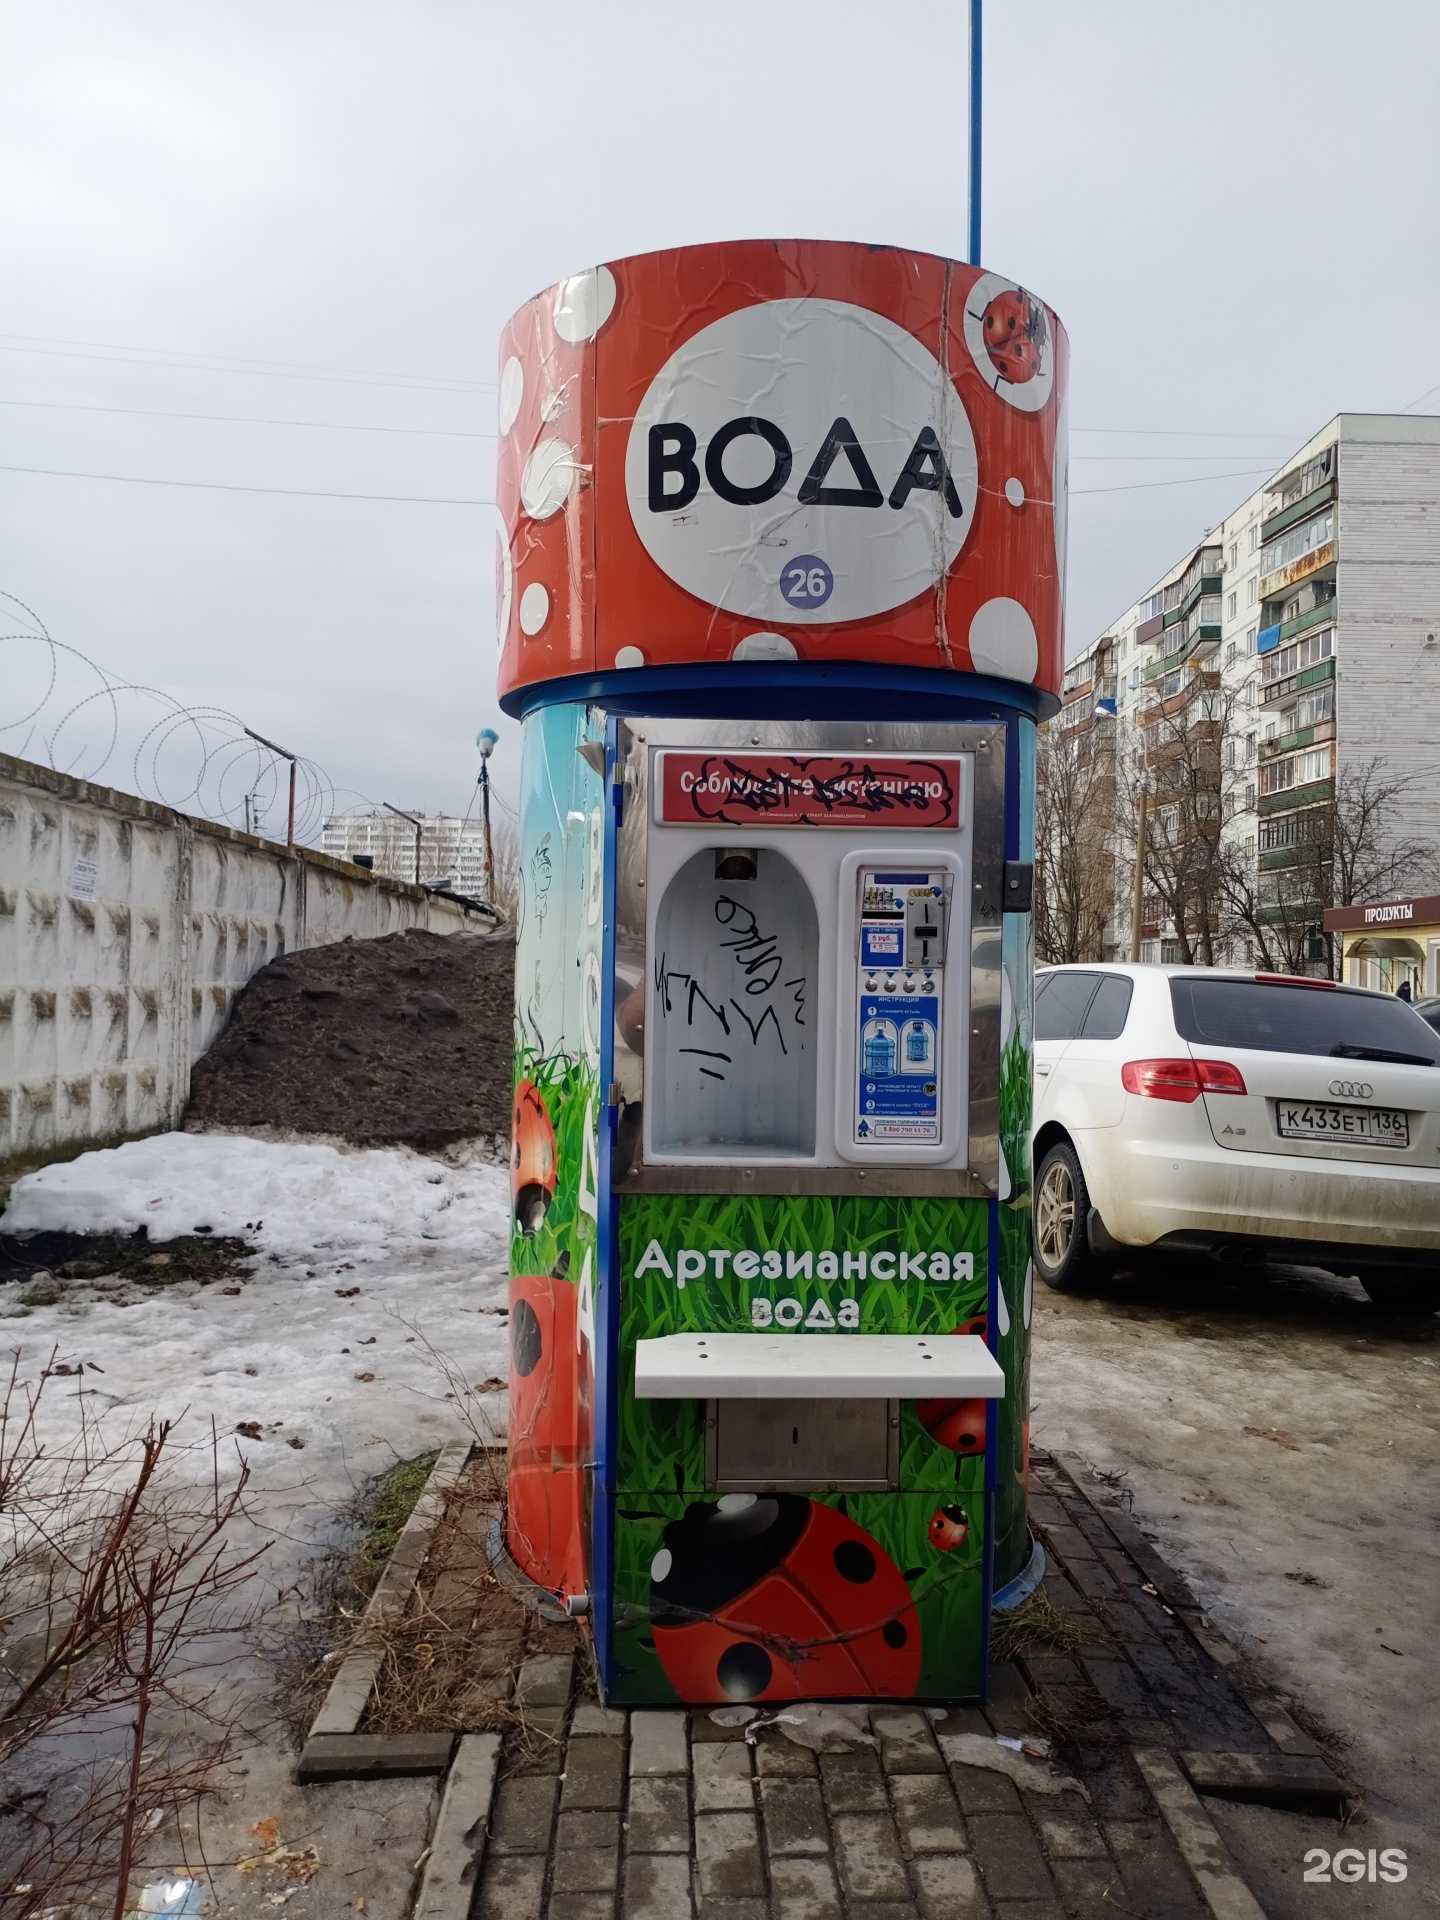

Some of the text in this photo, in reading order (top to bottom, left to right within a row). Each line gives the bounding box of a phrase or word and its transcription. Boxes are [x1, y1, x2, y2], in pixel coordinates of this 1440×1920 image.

[648, 416, 963, 518] ВОДА
[788, 569, 826, 598] 26
[1364, 904, 1413, 923] ПРОДУКТЫ
[1372, 1113, 1402, 1130] 136
[634, 1239, 974, 1289] Артезианская
[751, 1298, 860, 1328] вода
